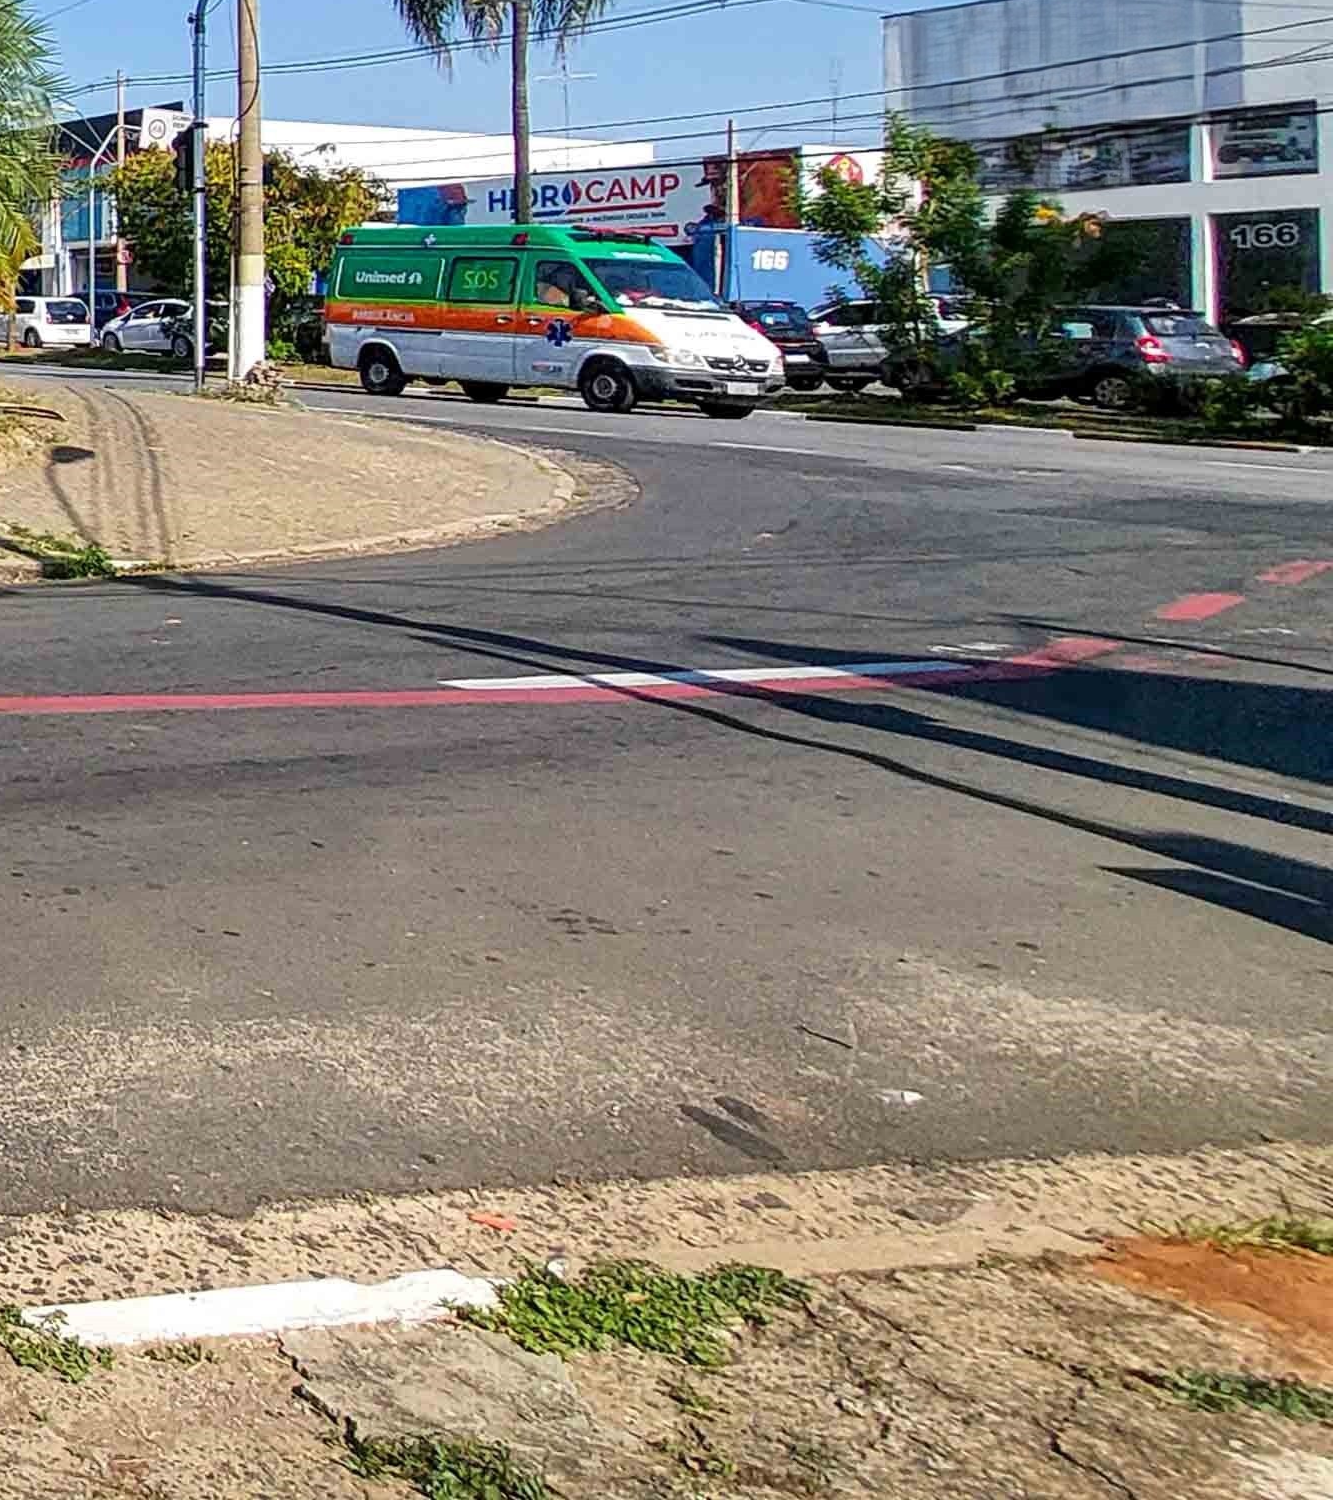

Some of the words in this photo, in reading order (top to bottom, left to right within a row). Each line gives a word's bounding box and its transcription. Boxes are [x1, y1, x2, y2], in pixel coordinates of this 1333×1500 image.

[1229, 221, 1300, 249] 166
[750, 249, 790, 271] 166
[355, 270, 407, 285] Unimed
[462, 269, 500, 290] SOS
